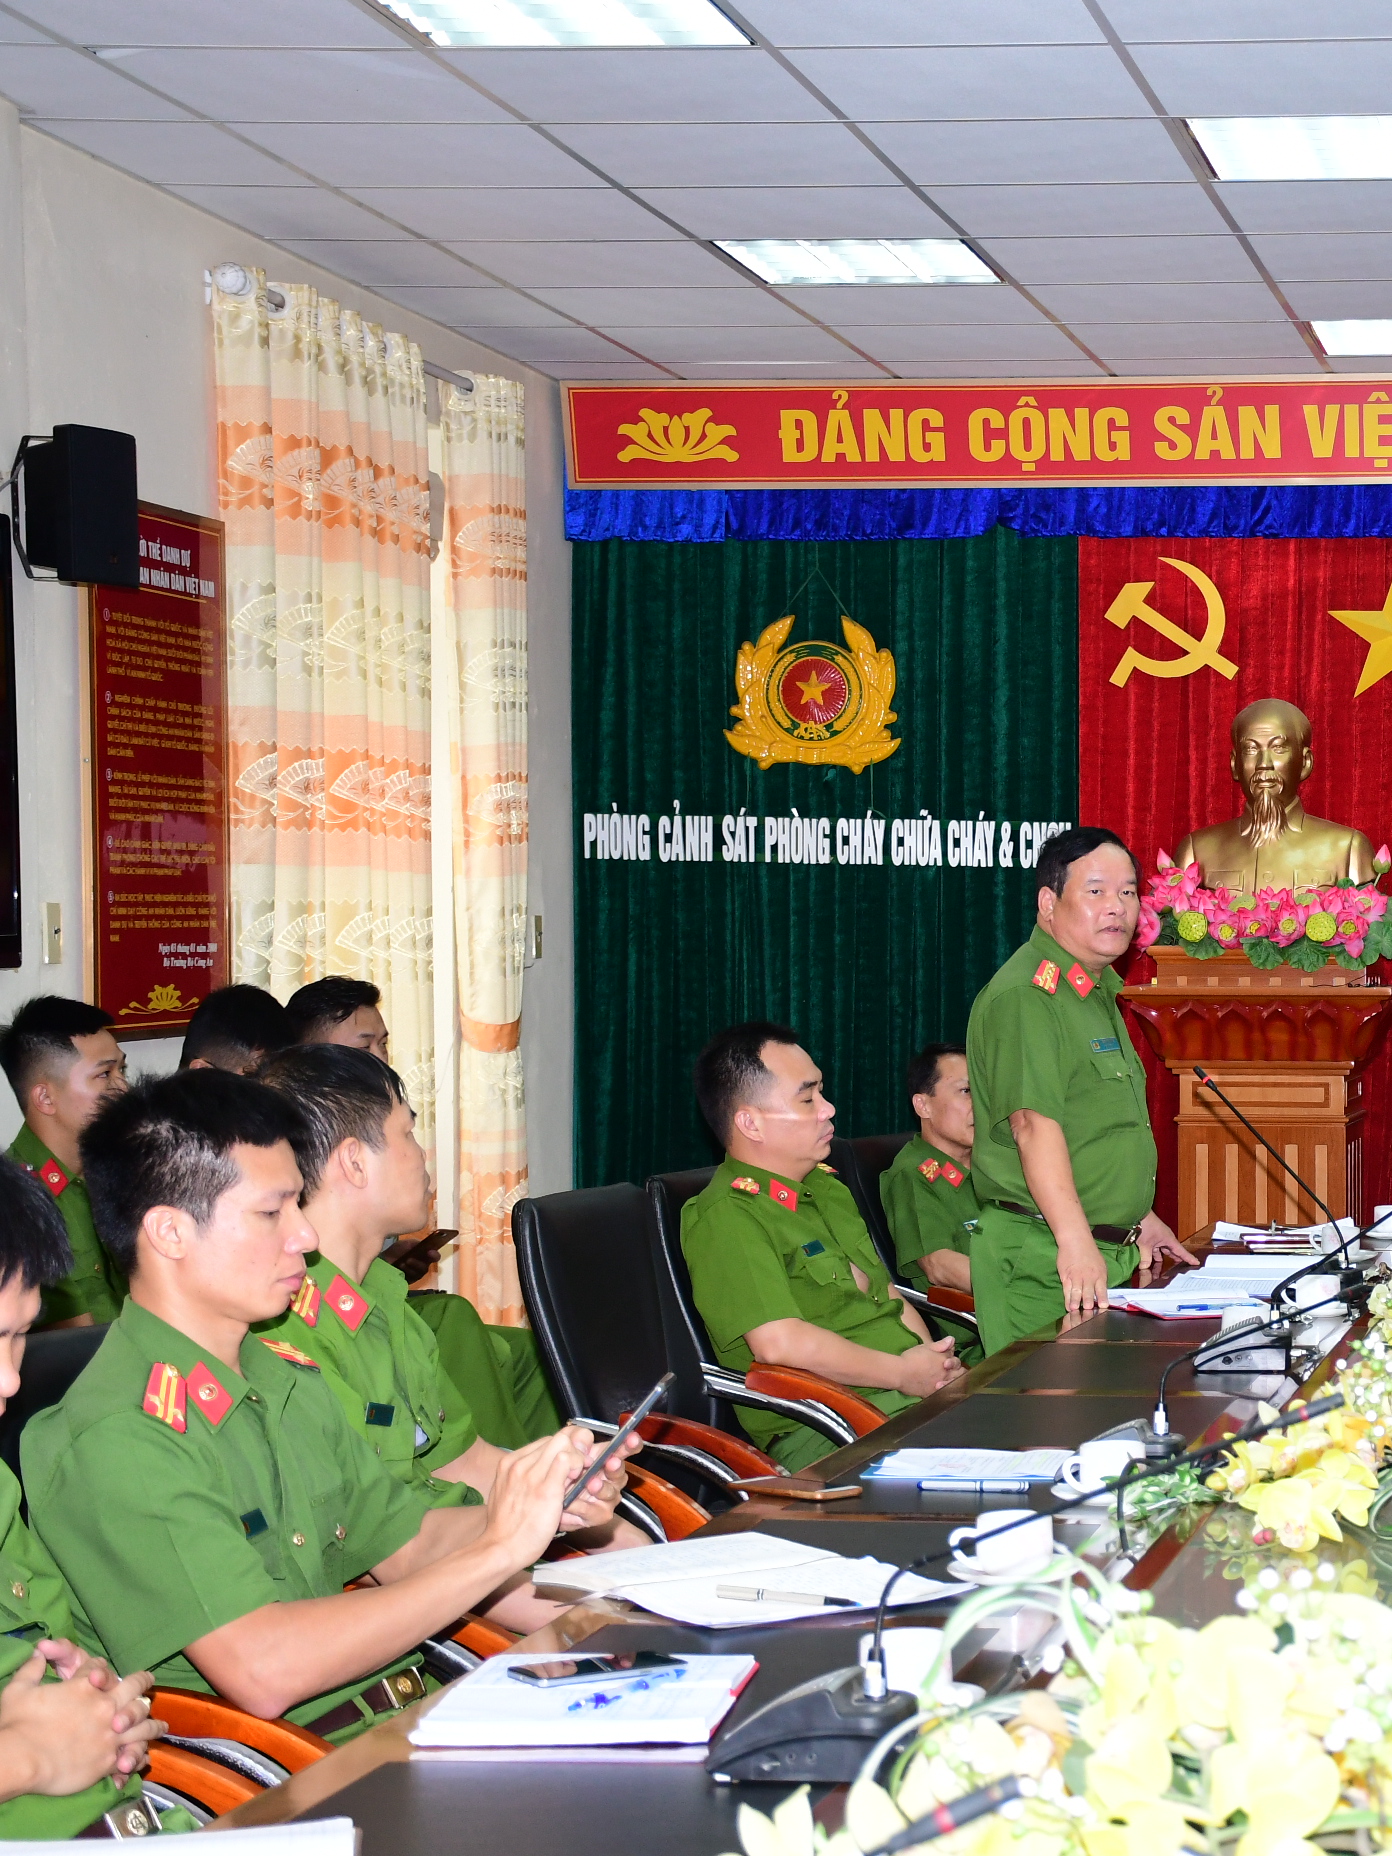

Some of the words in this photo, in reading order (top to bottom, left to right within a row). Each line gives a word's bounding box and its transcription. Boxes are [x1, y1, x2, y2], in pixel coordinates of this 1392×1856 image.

[779, 389, 945, 463] ĐẢNG
[968, 396, 1131, 471] CỘNG
[1154, 385, 1281, 460] SẢN
[162, 545, 180, 565] DANH
[139, 566, 150, 585] AN
[151, 567, 170, 589] NHÂN
[171, 570, 185, 592] DÂN
[185, 573, 199, 598] VIỆT
[200, 579, 215, 598] NAM
[584, 802, 650, 861] PHÒNG
[658, 799, 713, 863] CẢNH
[722, 807, 758, 863] SÁT
[764, 807, 831, 865] PHÒNG
[836, 809, 886, 866] CHÁY
[890, 809, 943, 867] CHỮA
[947, 810, 996, 868] CHÁY
[999, 821, 1014, 868] &
